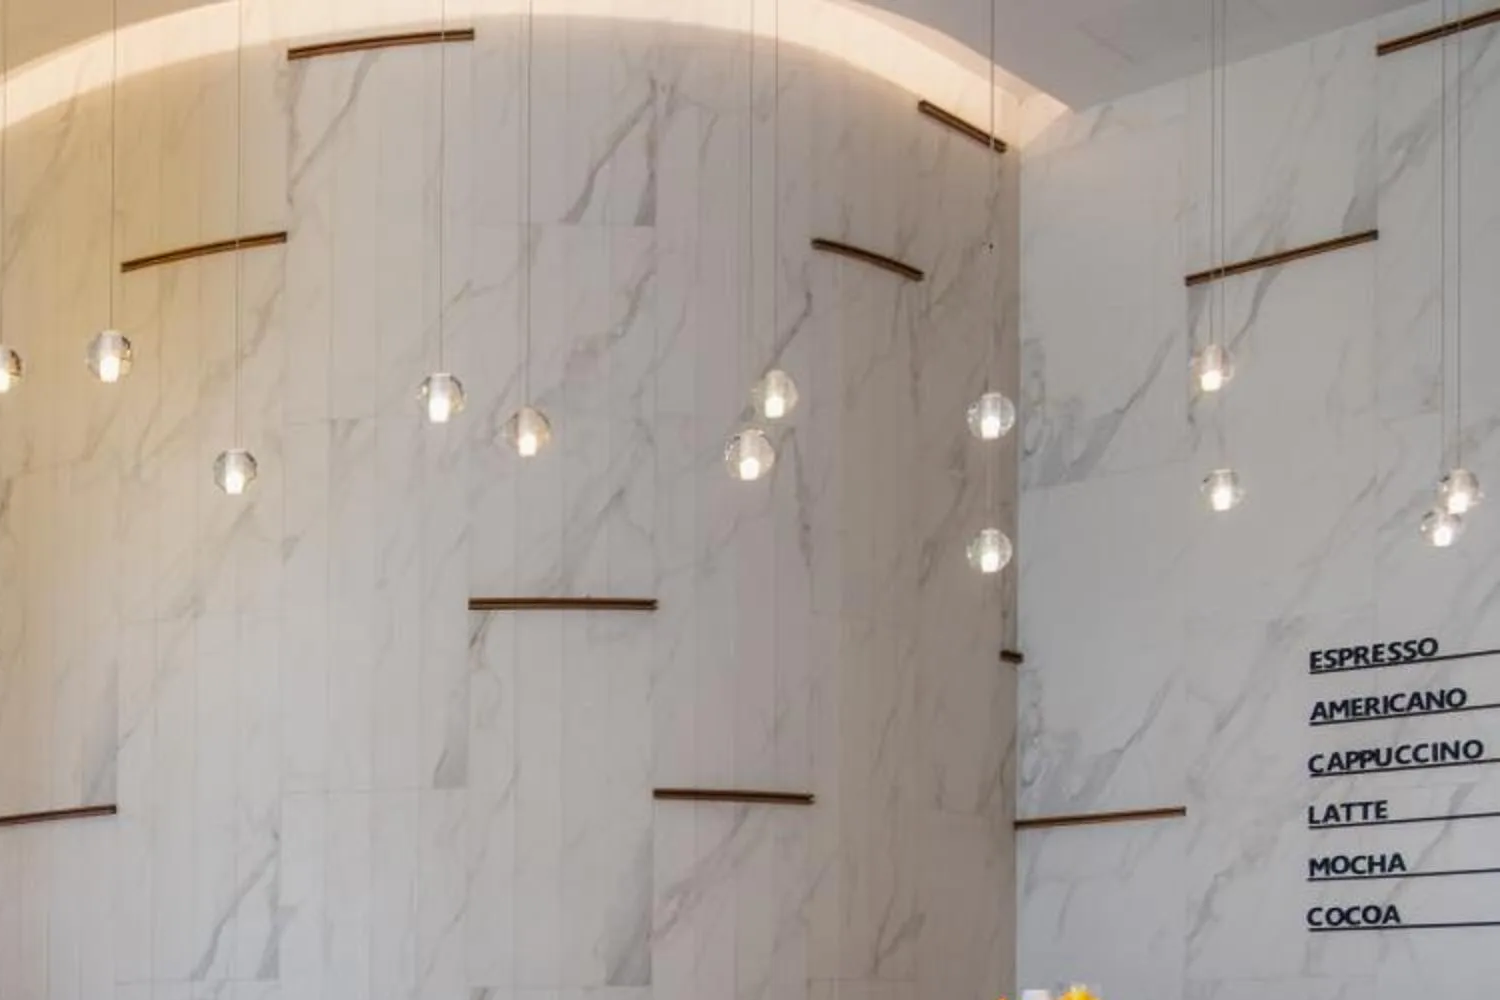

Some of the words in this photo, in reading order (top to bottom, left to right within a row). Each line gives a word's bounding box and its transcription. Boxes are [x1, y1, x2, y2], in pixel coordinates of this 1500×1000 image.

[1309, 637, 1439, 671] ESPRESSO
[1310, 687, 1467, 721] AMERICANO
[1308, 739, 1483, 773] CAPPUCCINO
[1309, 800, 1388, 824] LATTE
[1309, 853, 1406, 877] MOCHA
[1307, 905, 1401, 926] COCOA
